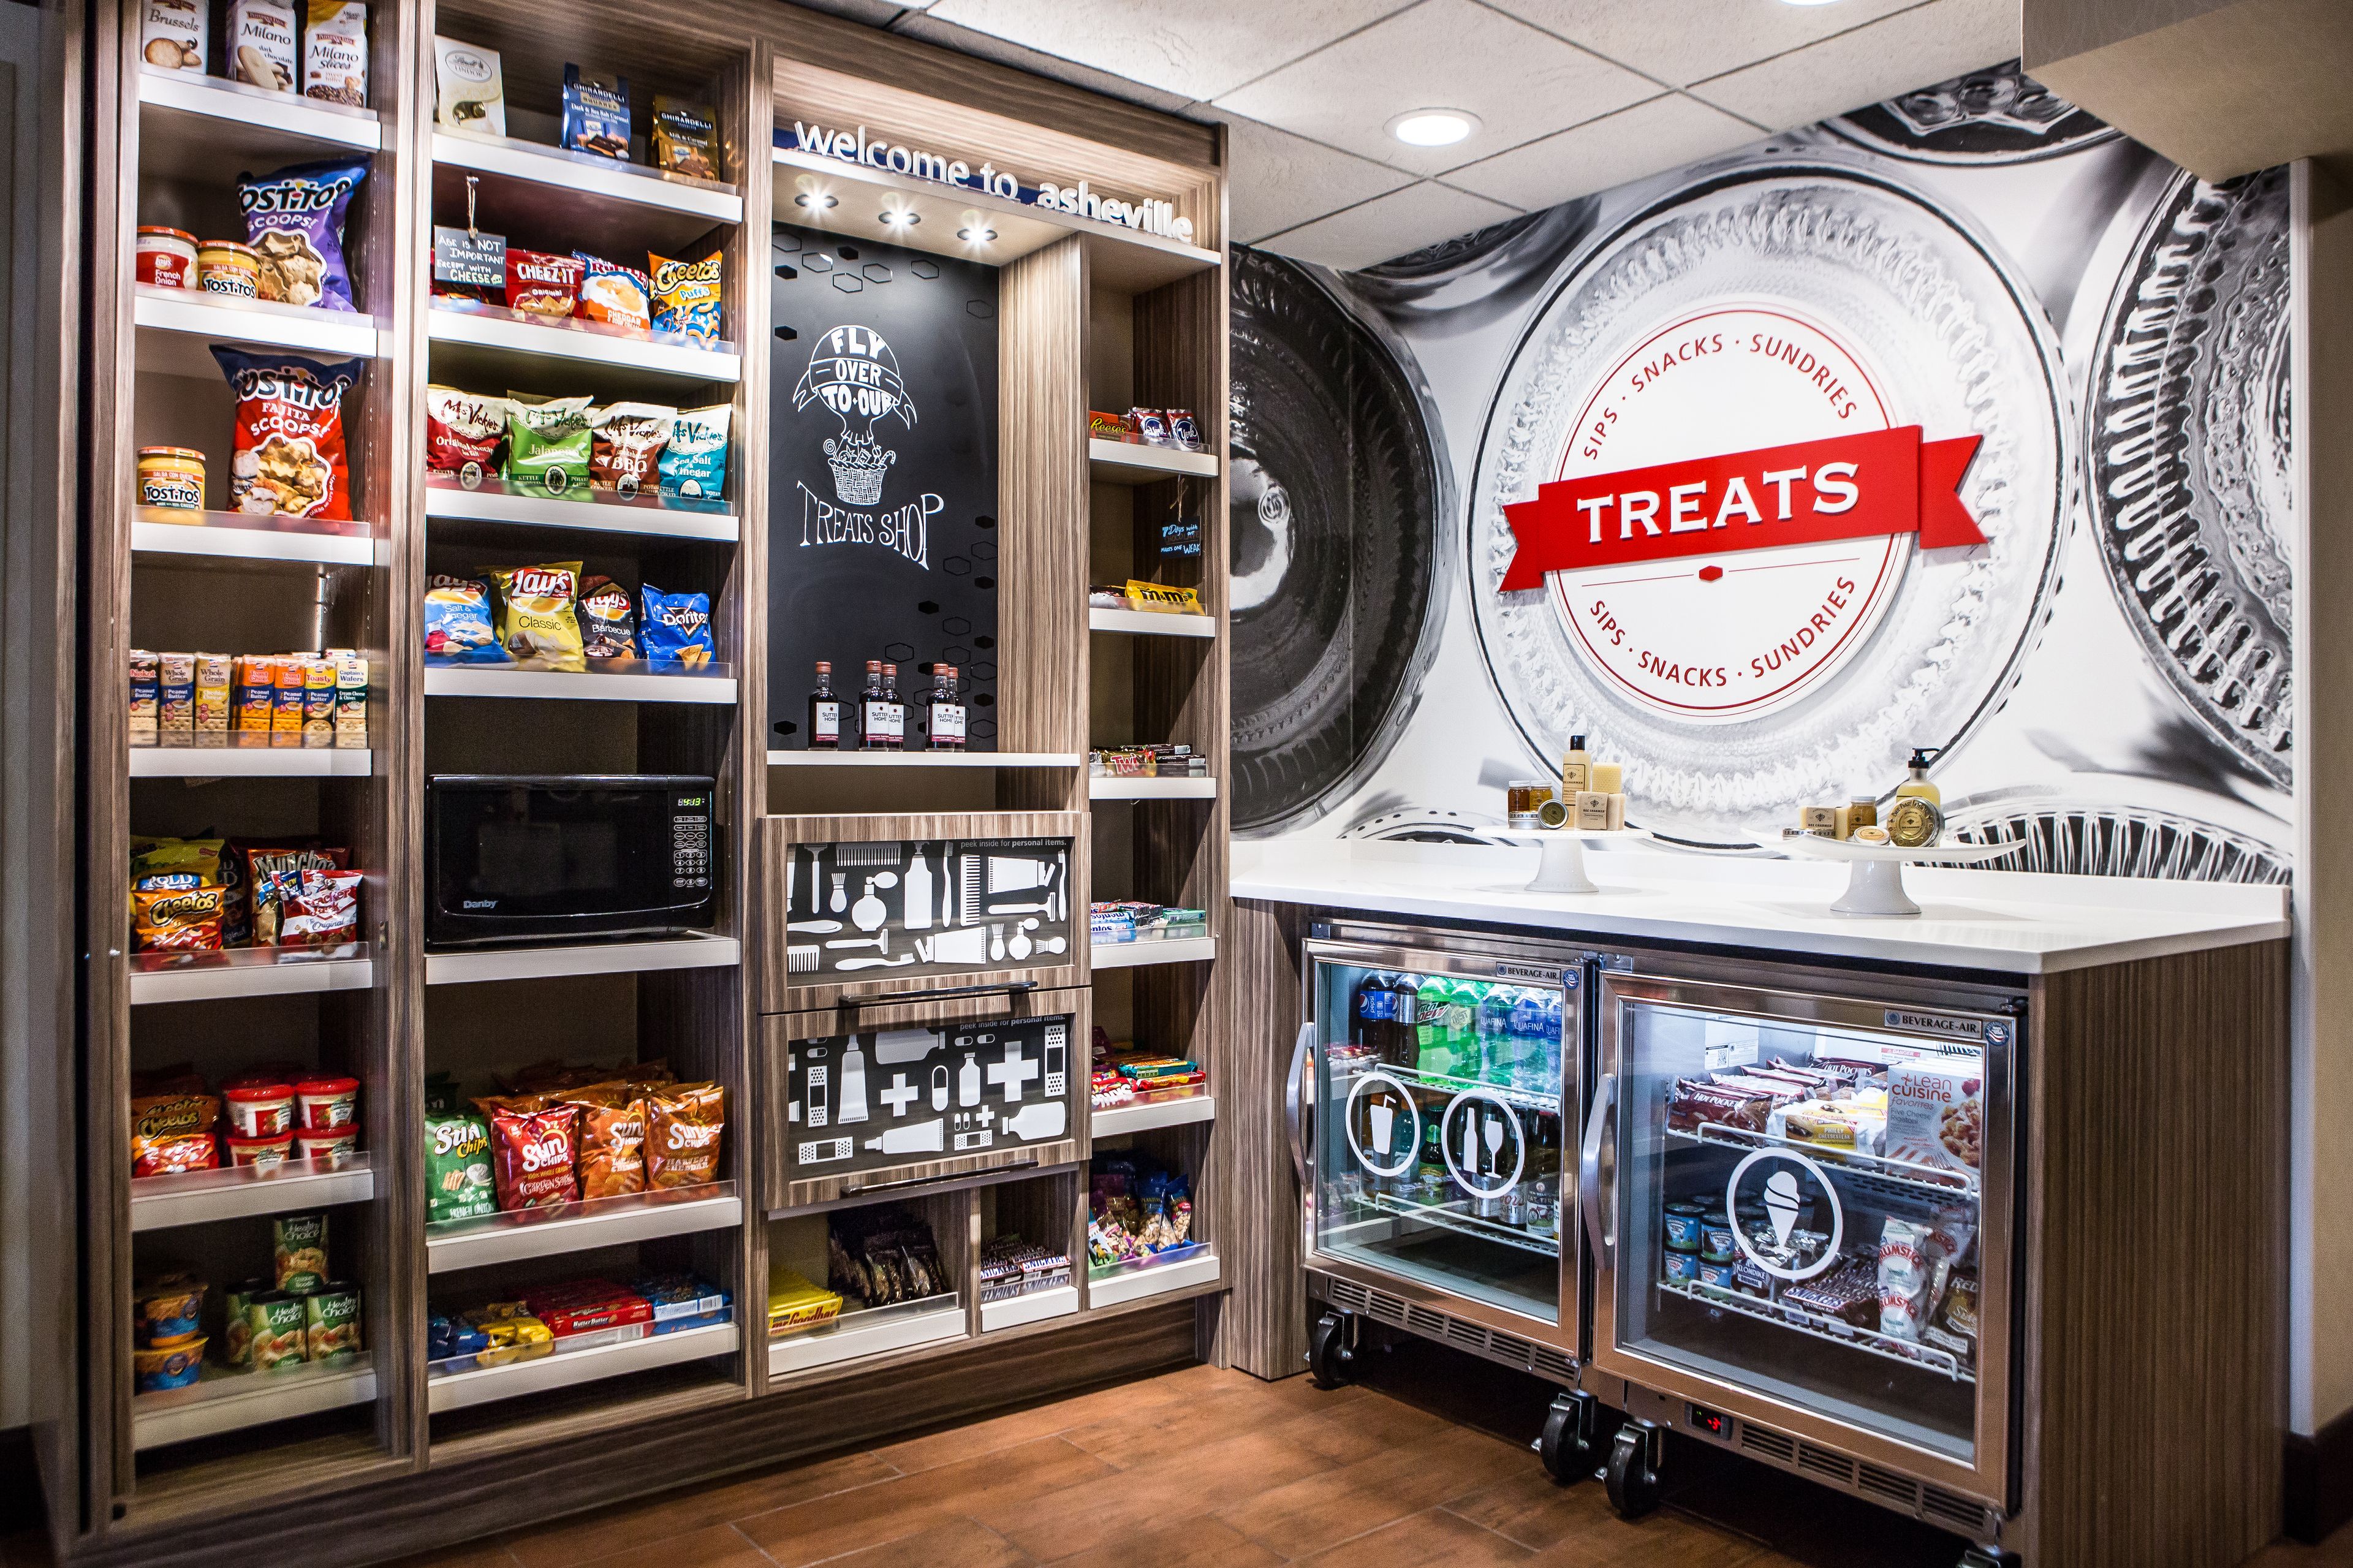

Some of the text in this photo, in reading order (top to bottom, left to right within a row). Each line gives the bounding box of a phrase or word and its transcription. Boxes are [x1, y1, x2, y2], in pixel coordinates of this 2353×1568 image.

[148, 9, 201, 32] Brussels
[241, 23, 291, 45] Milano
[309, 45, 359, 62] Milano
[573, 82, 625, 104] GHIRARDELLI
[571, 103, 584, 112] Dark
[661, 112, 712, 131] GHIRARDELLI
[669, 131, 681, 140] Milk
[794, 120, 1193, 243] welcome to asheville
[248, 214, 319, 232] SCOOPS!
[438, 234, 502, 253] AGE IS NOT
[449, 247, 506, 265] IMPORTANT
[436, 259, 465, 270] EXCEPT
[155, 270, 181, 281] French
[155, 276, 177, 287] Onion
[450, 269, 491, 284] CHEESE
[656, 262, 721, 290] Cheetos
[679, 287, 711, 300] Puffs
[830, 327, 886, 360] FLY
[835, 359, 882, 387] OVER
[822, 384, 894, 416] TO OUR
[1584, 333, 1857, 460] SIPS SNACKS SUNDRIES
[262, 401, 311, 422] FAJITA
[469, 403, 498, 433] Vickie's
[250, 415, 330, 439] SCOOPS!
[688, 422, 724, 445] Vickie's
[1090, 418, 1127, 434] Reese's
[1178, 425, 1197, 442] York
[611, 456, 648, 472] BBQ
[673, 454, 711, 466] Sea Salt
[672, 467, 711, 479] Vinegar
[1577, 461, 1860, 545] TREATS
[797, 480, 944, 570] TREATS SHOP
[1162, 526, 1169, 537] 7
[1168, 524, 1184, 536] Days
[1183, 543, 1200, 555] WEAK
[511, 569, 574, 598] Lay's
[445, 604, 463, 613] Salt
[518, 616, 562, 631] Classic
[592, 624, 631, 636] Barbecue
[1590, 576, 1855, 688] SIPS SNACKS SUNDRIES
[306, 673, 332, 683] Toasty
[1012, 839, 1043, 849] personal
[151, 890, 216, 926] Cheetos
[463, 899, 498, 911] Danby
[312, 919, 344, 931] Original
[1507, 967, 1558, 980] BEVERAGE-AIR
[960, 1023, 977, 1031] peek
[978, 1020, 998, 1028] inside
[1011, 1016, 1042, 1026] personal
[1514, 1020, 1544, 1033] AQUAFINA
[1902, 1015, 1977, 1034] BEVERAGE-AIR
[1914, 1075, 1952, 1091] Lean
[1693, 1092, 1709, 1102] HOT
[457, 1137, 488, 1158] Chips
[521, 1129, 568, 1172] Sun
[1025, 1256, 1066, 1269] SNICKERS
[591, 1317, 609, 1325] Butter
